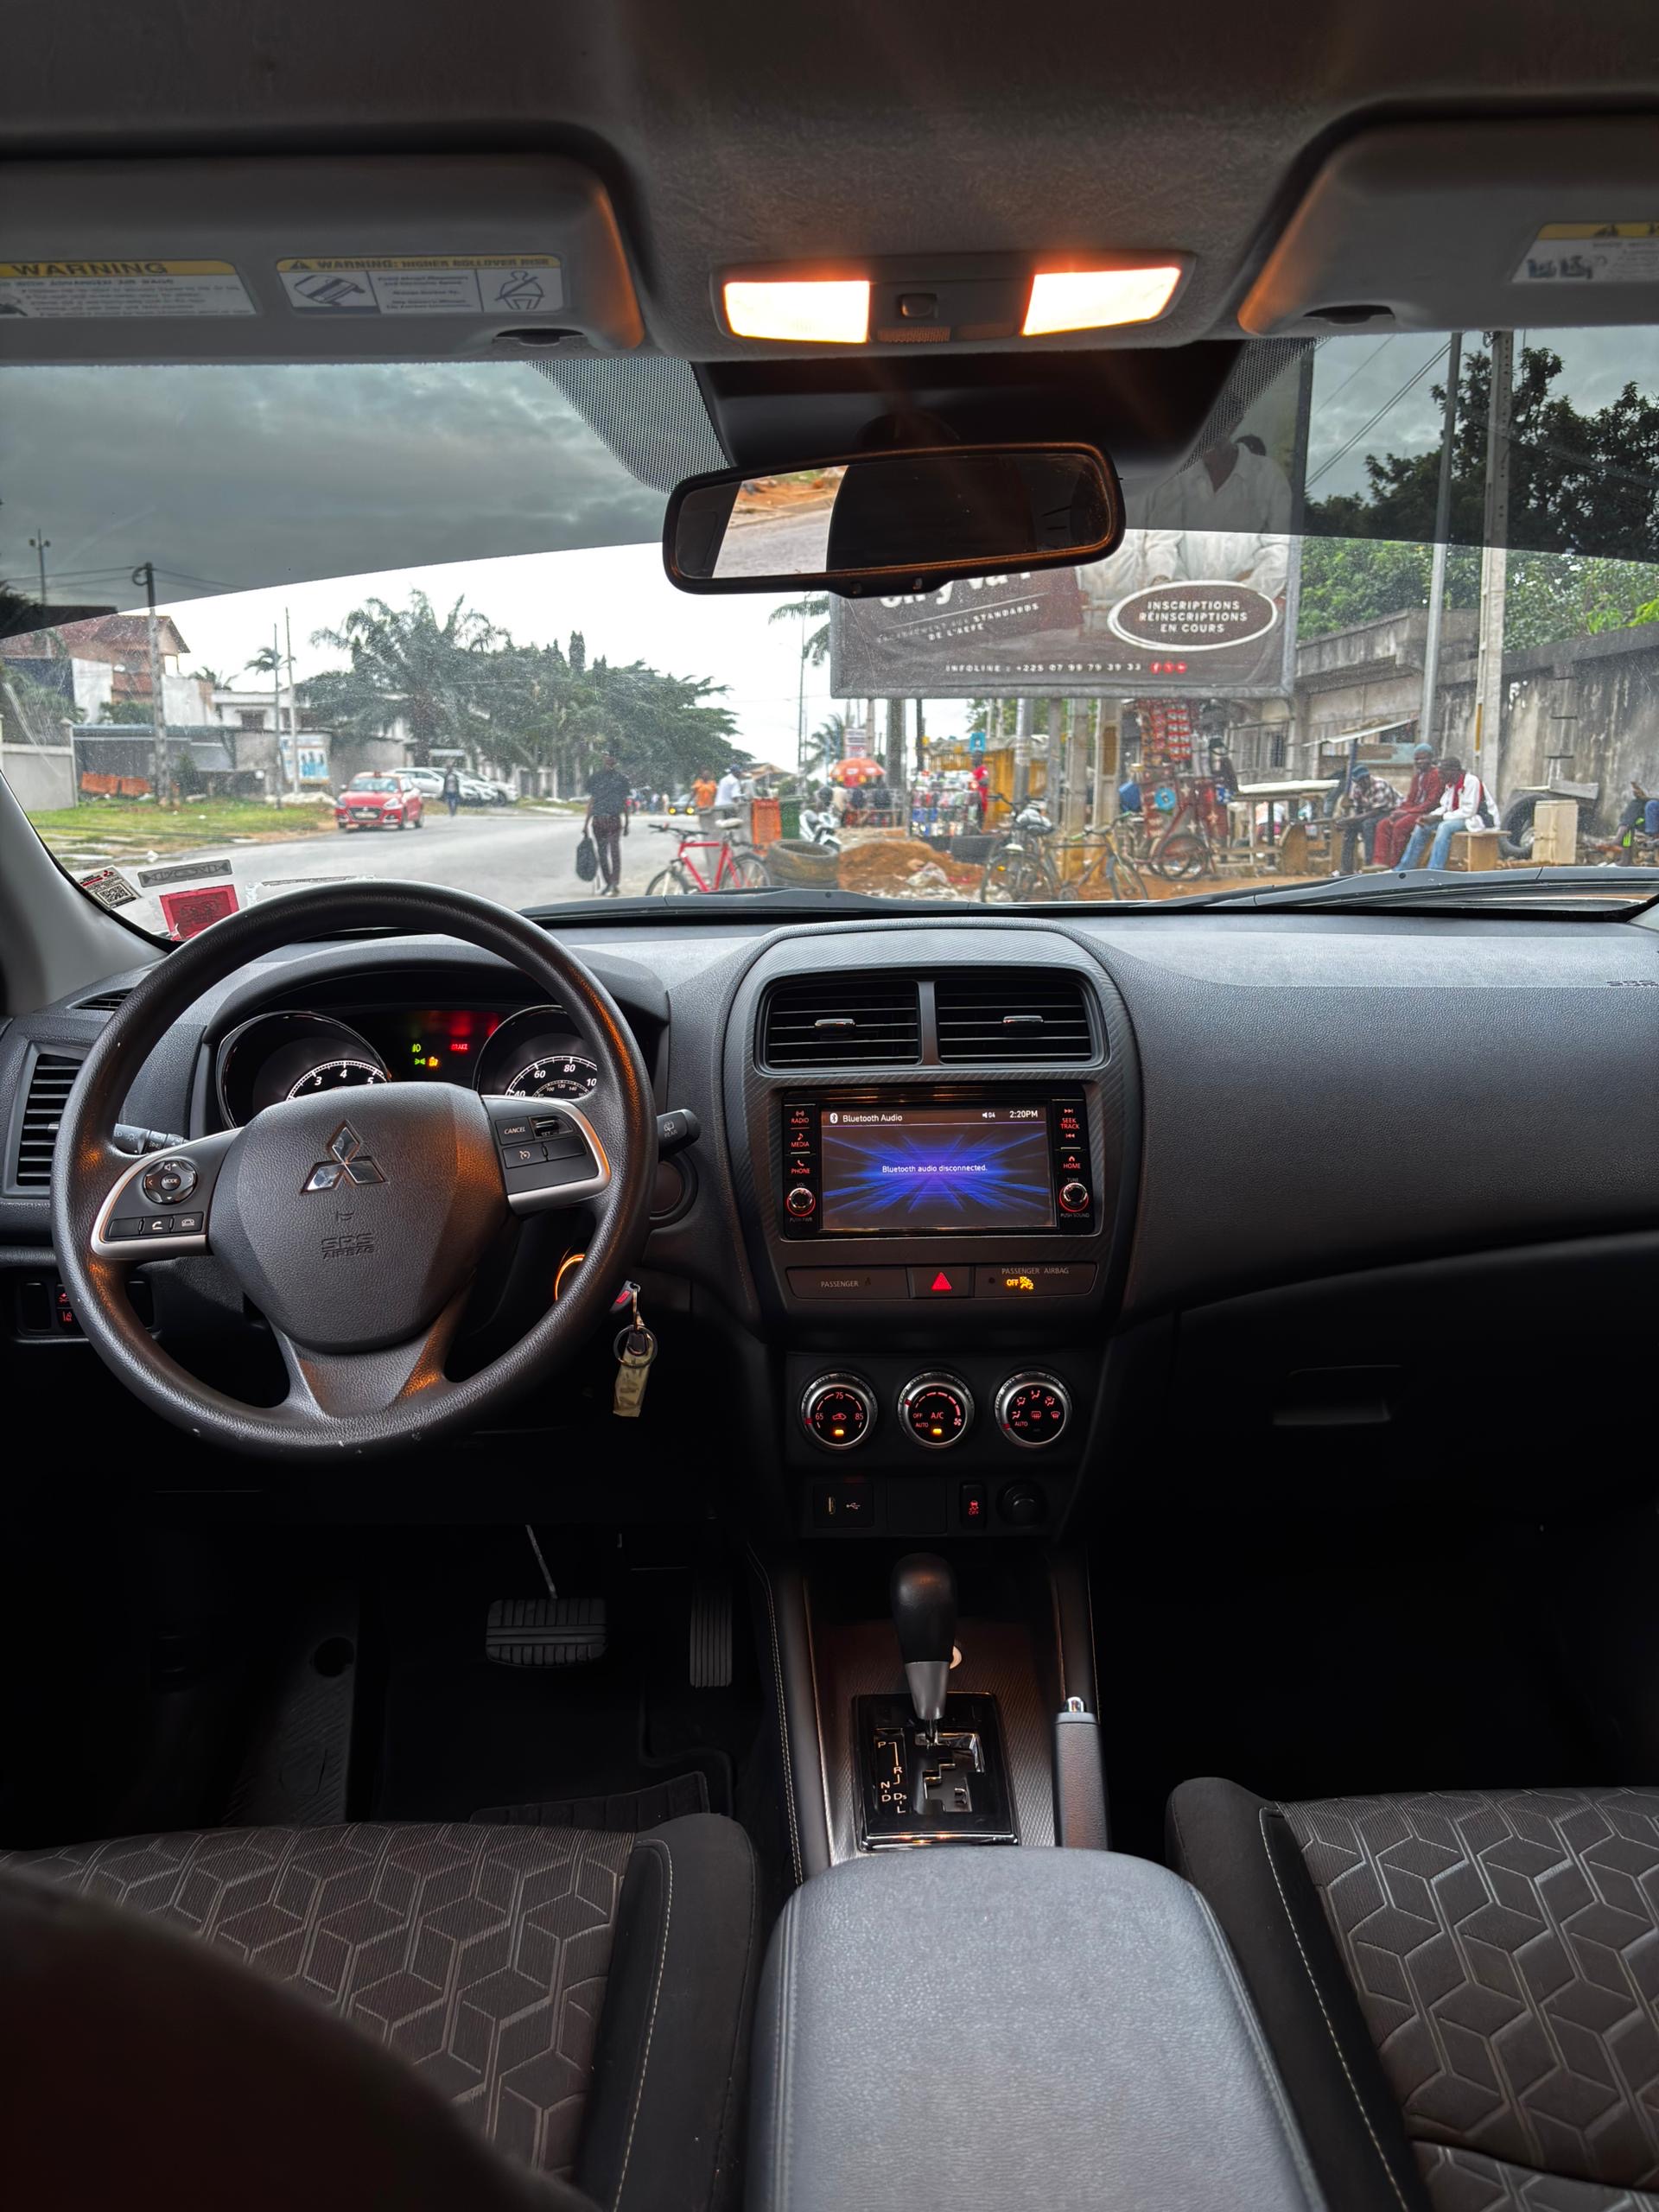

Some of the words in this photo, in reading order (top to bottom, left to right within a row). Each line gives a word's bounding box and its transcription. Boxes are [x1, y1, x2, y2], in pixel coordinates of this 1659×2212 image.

[317, 259, 397, 269] WARNING:
[11, 262, 168, 276] WARNING
[1147, 601, 1241, 610] INSCRIPTIONS
[973, 603, 1039, 622] STANDARDS
[1160, 624, 1177, 632] EN
[1181, 624, 1225, 632] COURS
[928, 632, 943, 641] DE
[563, 1064, 576, 1072] 80
[340, 1069, 347, 1078] 4
[534, 1070, 546, 1078] 60
[314, 1076, 322, 1085] 3
[365, 1077, 374, 1085] 5
[842, 1114, 880, 1122] Bluetooth
[881, 1113, 903, 1122] Audio
